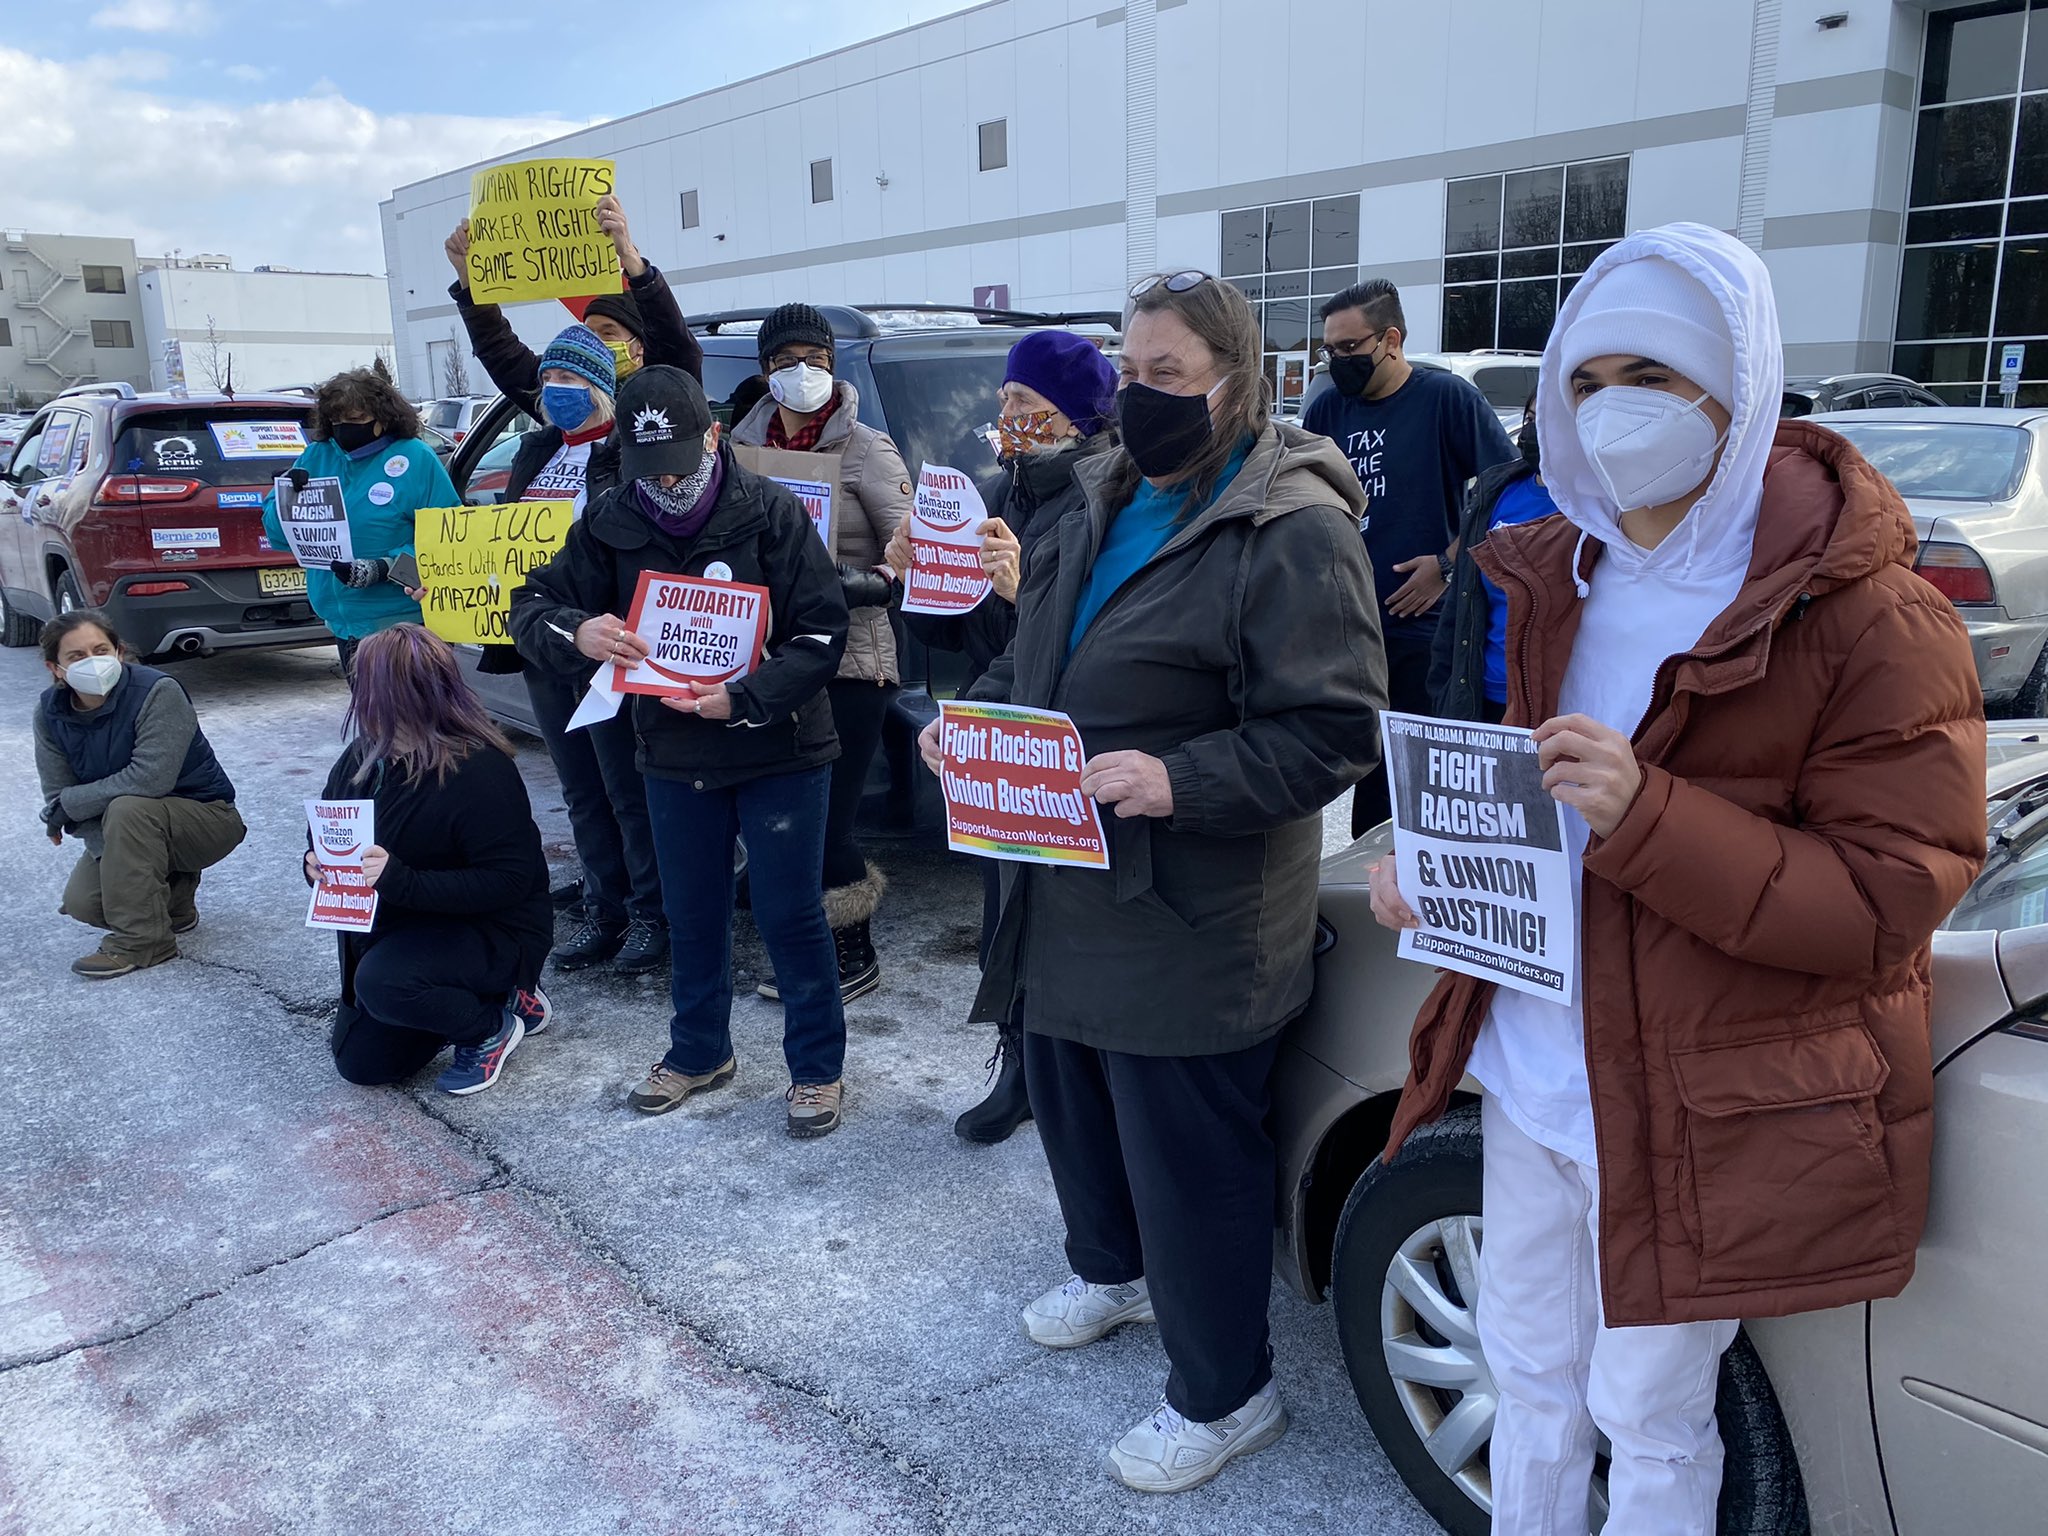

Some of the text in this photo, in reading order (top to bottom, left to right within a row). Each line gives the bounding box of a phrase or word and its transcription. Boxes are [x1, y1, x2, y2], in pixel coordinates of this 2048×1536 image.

[526, 166, 613, 200] RIGHTS
[472, 243, 620, 284] SAME STRUGGLE
[985, 290, 995, 317] 1
[1347, 428, 1386, 453] TAX
[157, 457, 203, 466] Bernie
[219, 493, 257, 503] Bernie
[298, 489, 325, 504] FIGHT
[929, 490, 942, 498] with
[1359, 475, 1386, 498] CH
[292, 505, 334, 520] RACISM
[800, 496, 823, 520] MA
[918, 493, 960, 510] BAmazon
[918, 506, 962, 522] WORKERS!
[154, 531, 218, 541] Bernie 2016
[292, 527, 337, 542] & UNION
[439, 506, 556, 544] NJ IUC
[296, 544, 343, 560] BUSTING!
[419, 549, 464, 580] Stands
[468, 548, 498, 575] With
[939, 547, 978, 568] Racism
[912, 568, 988, 598] Union Busting!
[430, 585, 500, 613] AMAZON
[656, 585, 756, 620] SOLIDARITY
[660, 622, 739, 650] BAmazon
[690, 615, 713, 630] with
[656, 642, 736, 669] WORKERS!
[944, 722, 1080, 772] Fight Racism &
[1390, 719, 1423, 738] SUPPORT
[1424, 726, 1464, 745] ALABAMA
[1465, 731, 1503, 749] AMAZON
[1428, 747, 1498, 795] FIGHT
[945, 770, 1088, 826] Union Busting!
[315, 806, 360, 819] SOLIDARITY
[1420, 791, 1527, 839] RACISM
[951, 816, 1100, 851] SupportAmazonWorkers.org
[1417, 850, 1538, 902] & UNION
[317, 890, 374, 913] Union Busting!
[1417, 896, 1547, 957] BUSTING!
[1415, 933, 1562, 989] SupportAmazonWorkers.org
